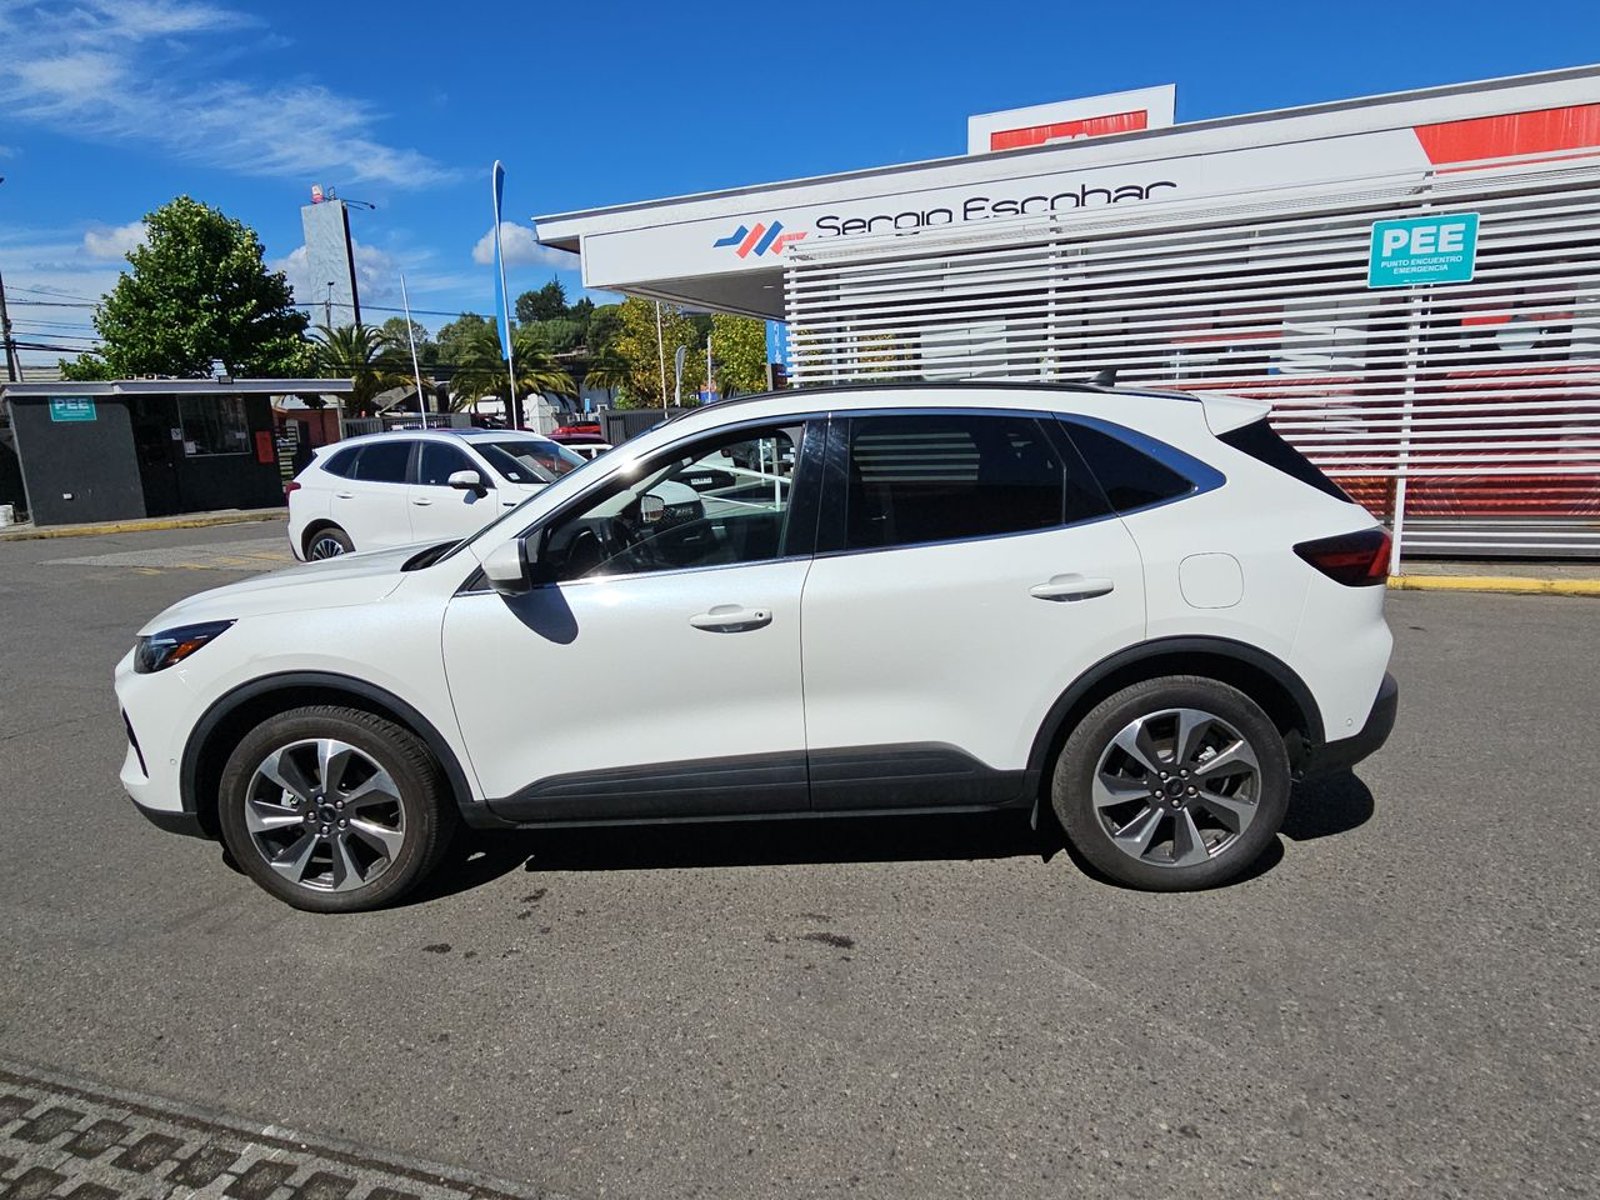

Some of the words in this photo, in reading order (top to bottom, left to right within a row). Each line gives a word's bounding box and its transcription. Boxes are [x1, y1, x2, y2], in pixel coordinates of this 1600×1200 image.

[816, 208, 953, 238] Sergio
[1382, 223, 1466, 257] PEE
[1381, 260, 1409, 268] PUNTO
[1410, 255, 1463, 265] ENCUENTRO
[1393, 264, 1449, 275] EMERGENCIA
[54, 398, 90, 410] PEE
